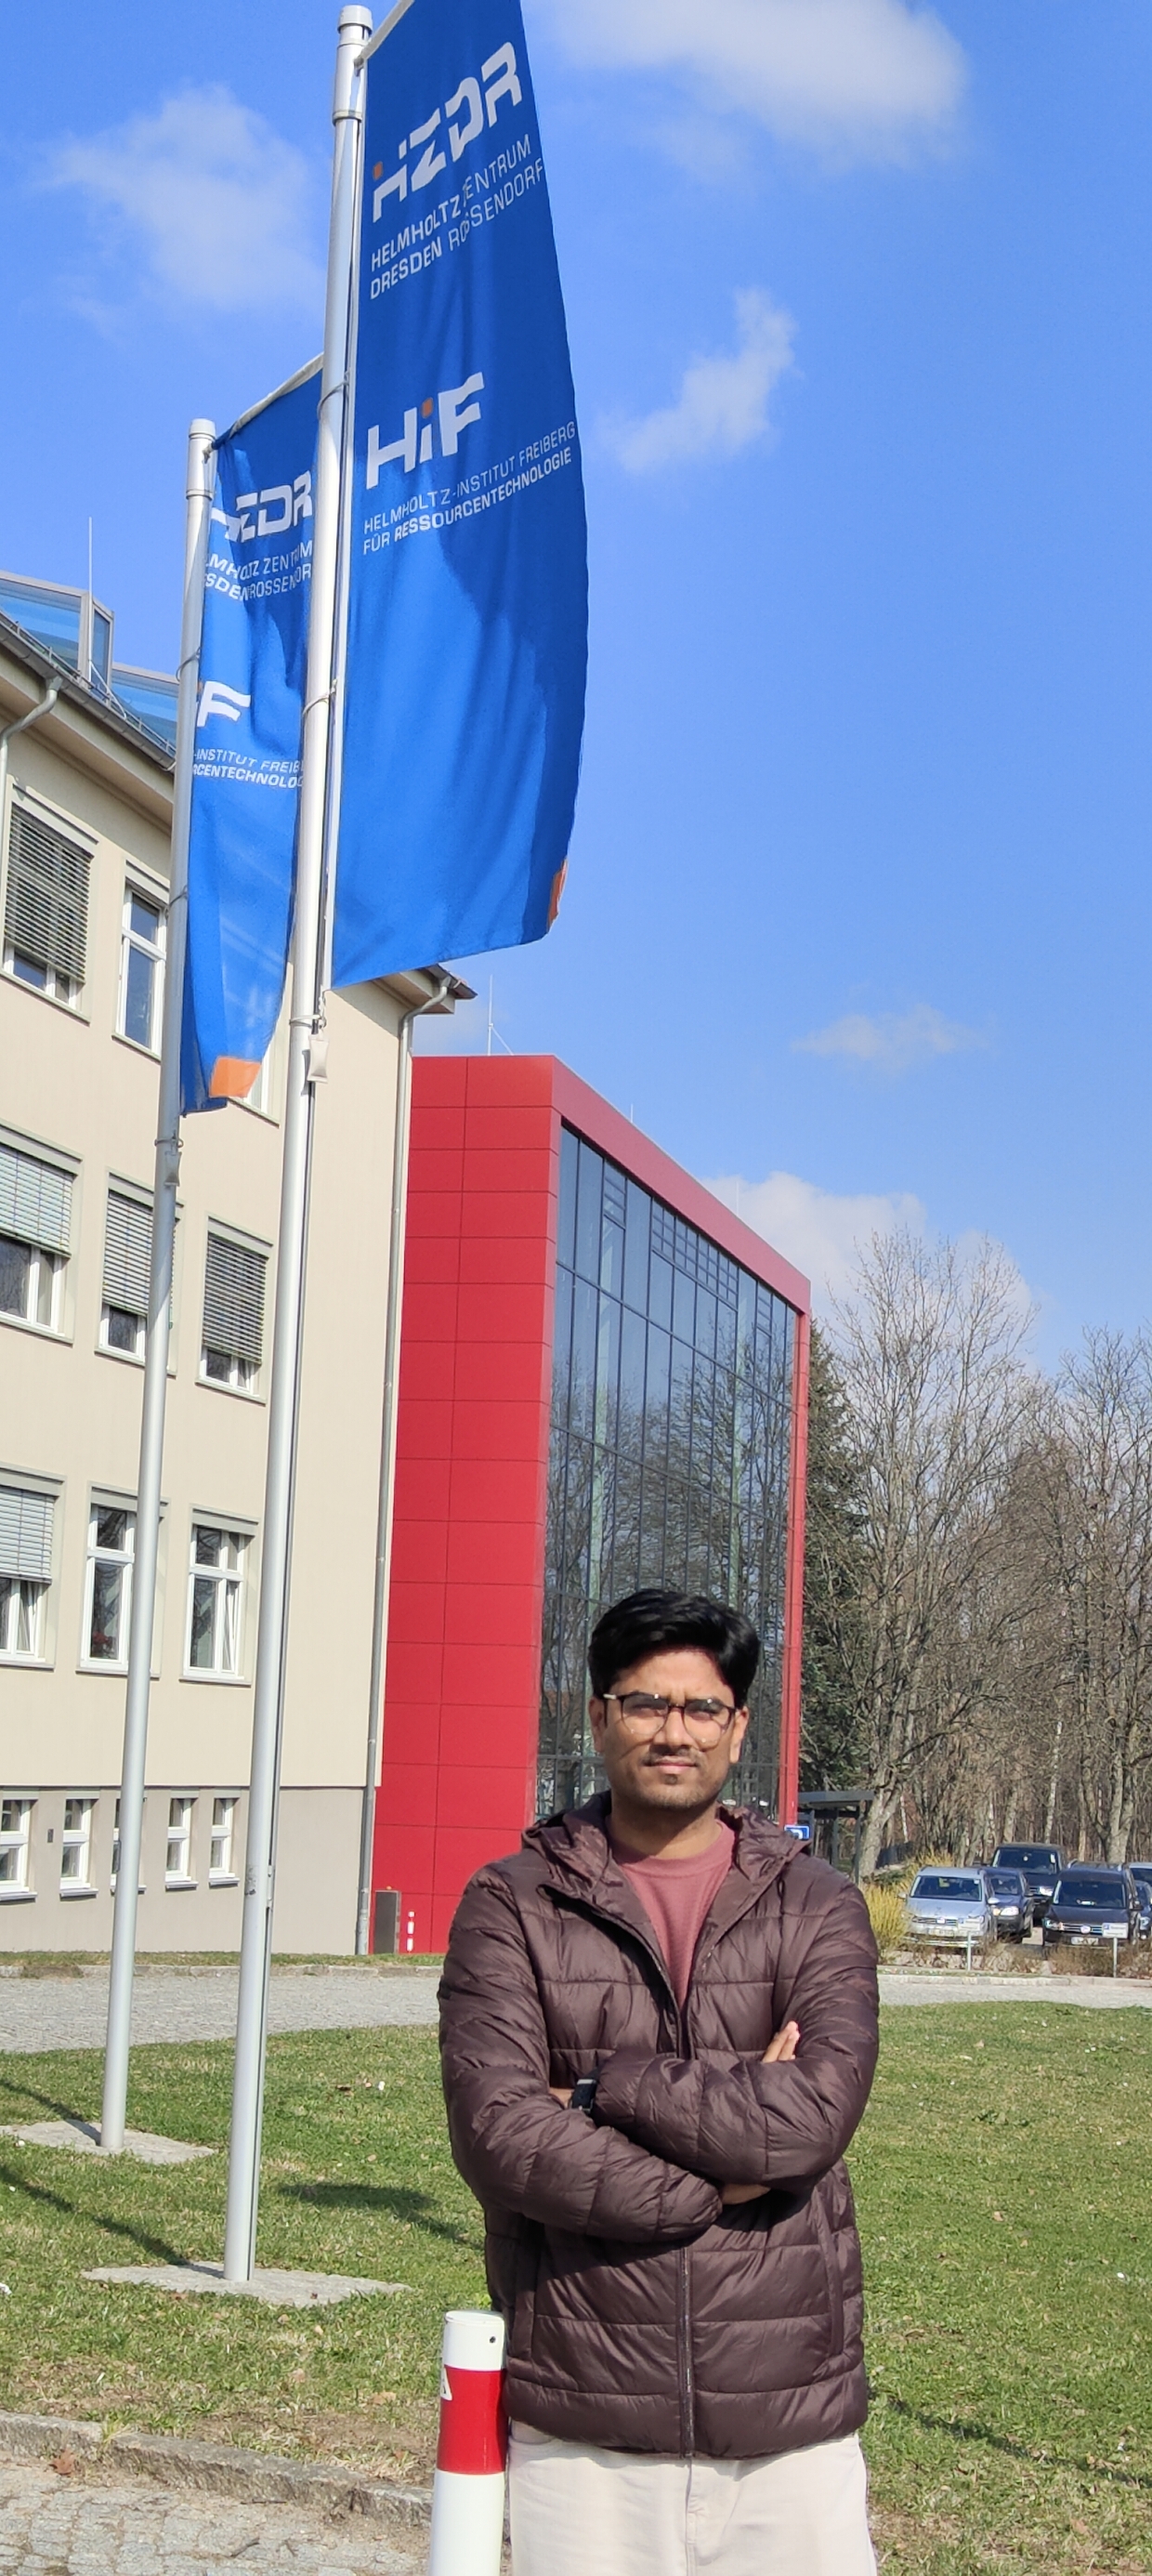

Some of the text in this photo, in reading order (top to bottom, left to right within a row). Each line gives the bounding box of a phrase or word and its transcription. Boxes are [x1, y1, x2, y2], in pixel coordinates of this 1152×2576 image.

[373, 41, 522, 223] HZDR
[370, 157, 543, 300] DRESDEN ROSENDORF
[372, 193, 462, 272] HELMHOLTZ
[363, 447, 571, 555] FÜR RESSOURCENTECHNOLOGIE
[364, 421, 576, 534] HELMHOLTZ-INSTITUT FREIBERG
[205, 573, 249, 601] SDEN
